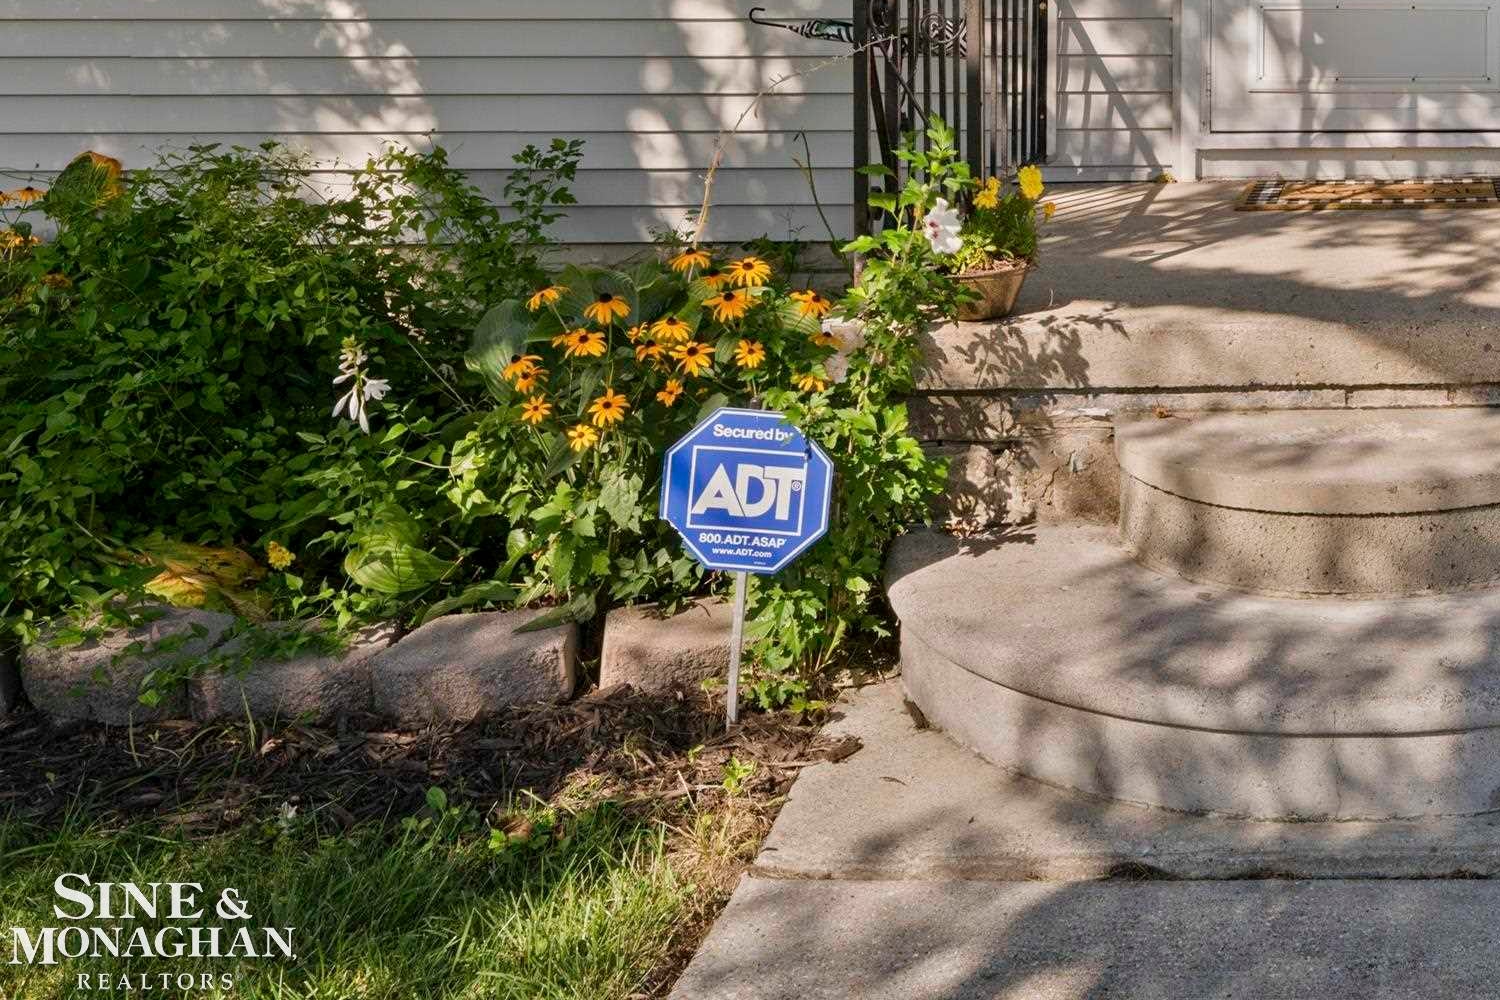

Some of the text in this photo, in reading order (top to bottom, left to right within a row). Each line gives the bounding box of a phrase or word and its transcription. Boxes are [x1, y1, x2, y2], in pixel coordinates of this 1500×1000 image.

[713, 423, 774, 441] Secured
[691, 462, 804, 521] ADT
[711, 547, 772, 559] www.ADT.com
